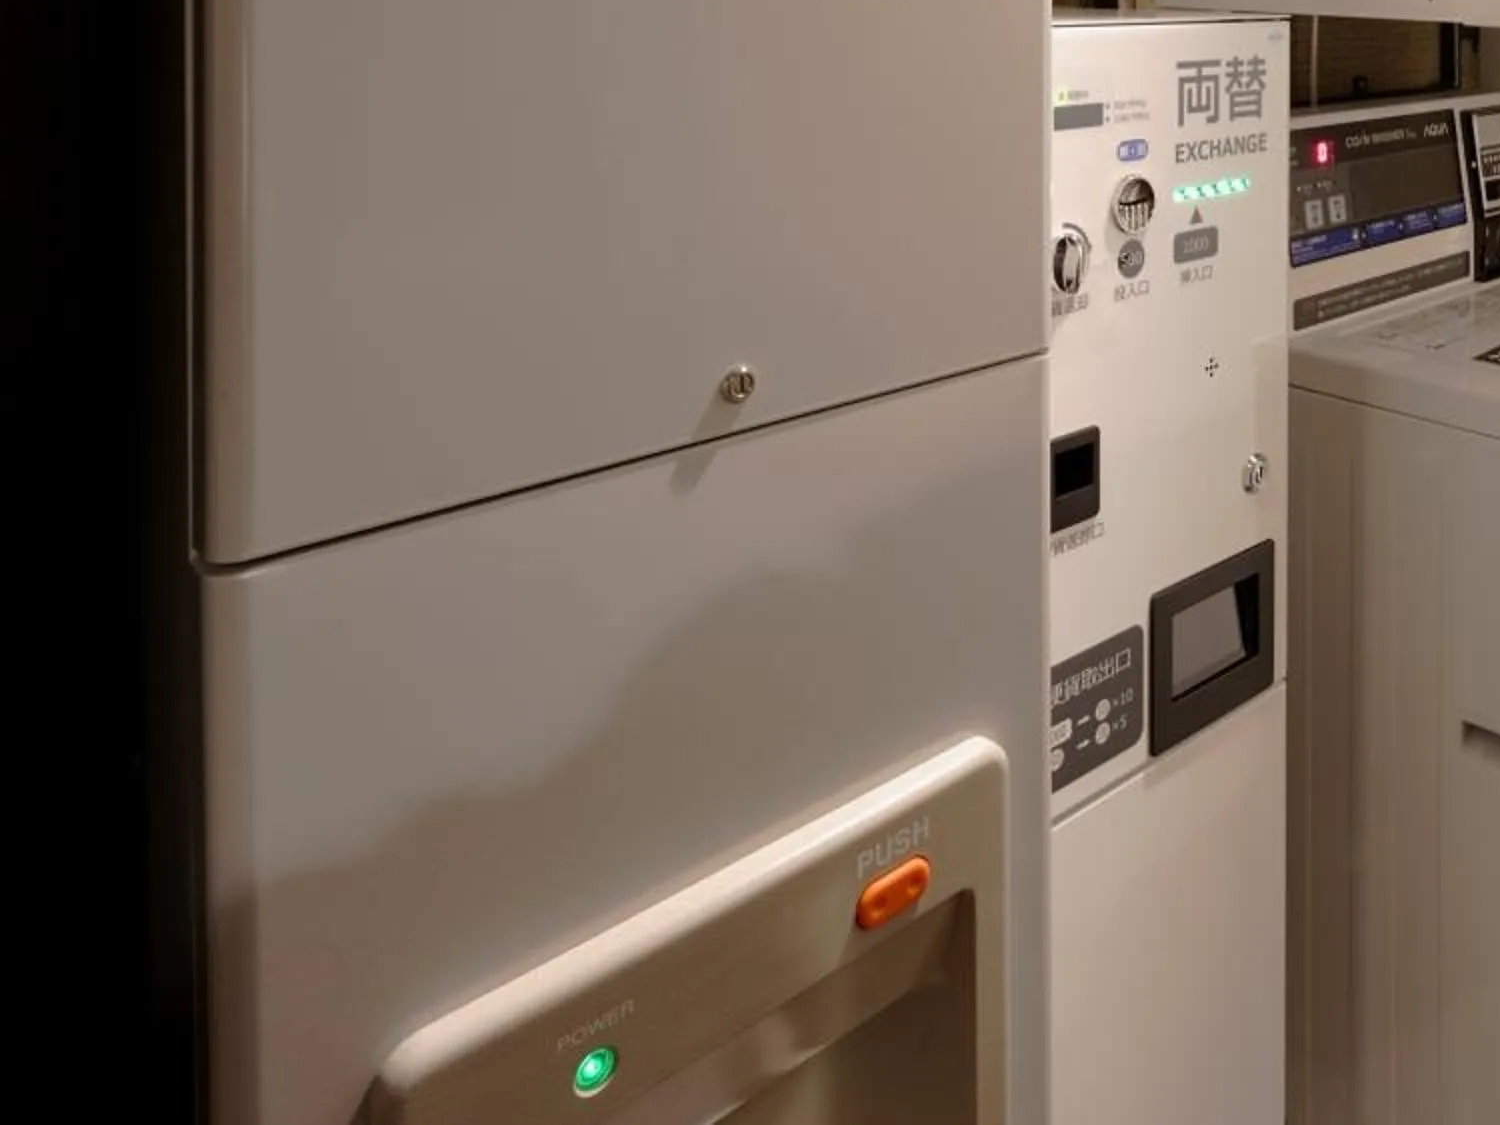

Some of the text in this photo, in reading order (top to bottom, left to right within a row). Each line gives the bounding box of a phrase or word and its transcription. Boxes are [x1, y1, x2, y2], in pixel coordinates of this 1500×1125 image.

[1176, 54, 1267, 128] 両替
[1175, 132, 1269, 164] EXCHANGE
[857, 815, 930, 881] PUSH
[557, 998, 635, 1053] POWER
